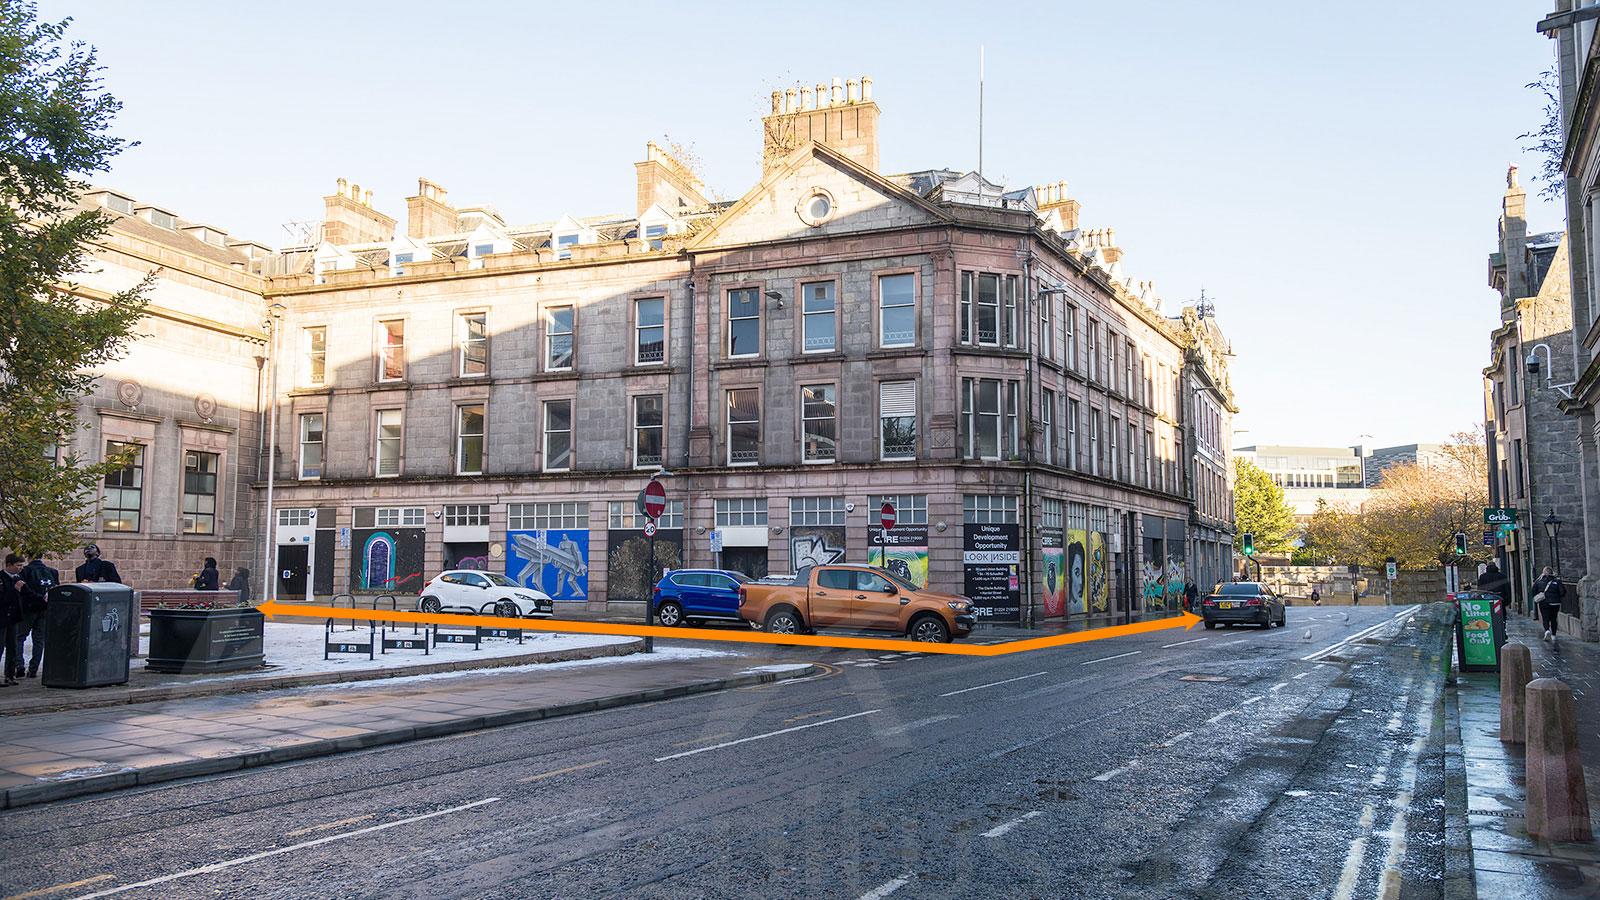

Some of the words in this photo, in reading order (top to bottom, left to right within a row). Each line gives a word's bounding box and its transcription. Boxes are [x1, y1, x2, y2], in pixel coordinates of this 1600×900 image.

[646, 525, 655, 533] 20
[990, 553, 1017, 562] INSIDE
[1461, 602, 1481, 611] No
[1466, 630, 1489, 638] Food
[1470, 637, 1491, 645] Only
